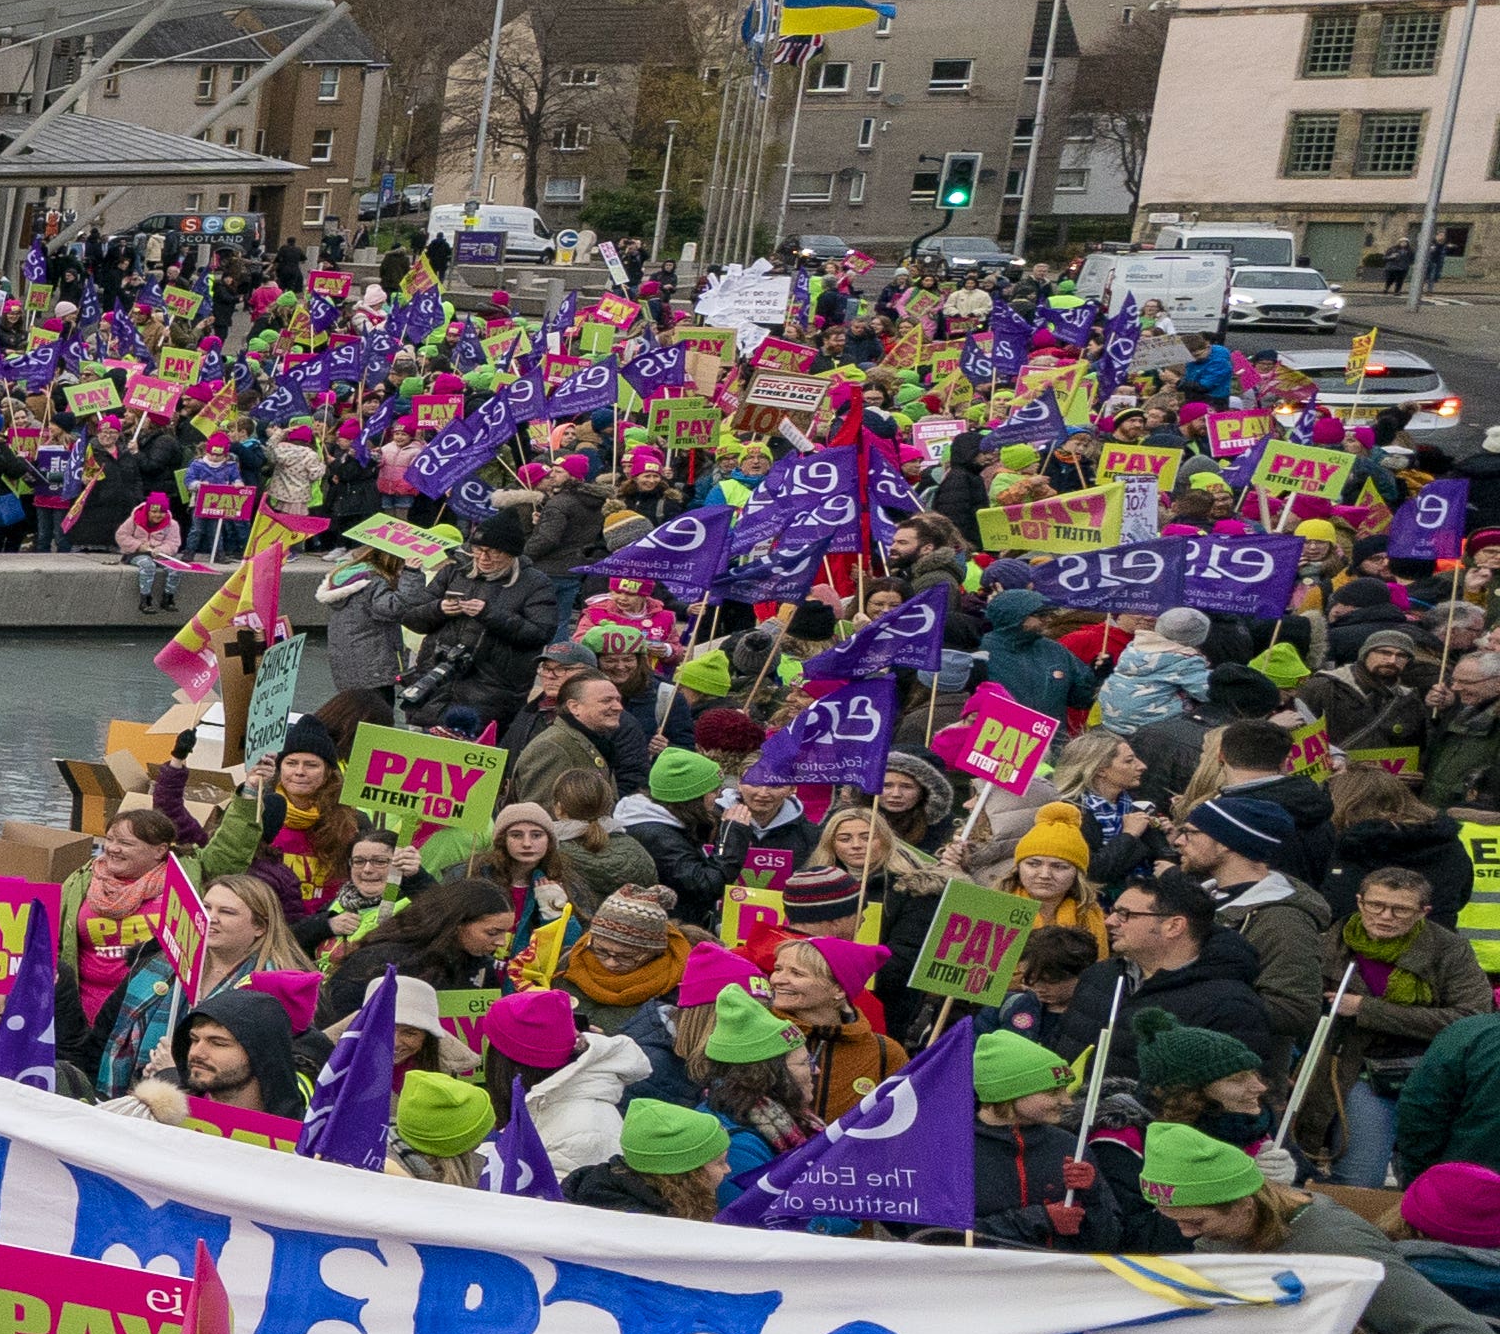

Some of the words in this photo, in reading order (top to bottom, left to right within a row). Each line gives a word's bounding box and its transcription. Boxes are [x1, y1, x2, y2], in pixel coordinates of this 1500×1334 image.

[179, 235, 244, 243] SCOTLAND
[753, 388, 787, 398] STRIKE
[789, 392, 818, 401] BACK
[756, 381, 822, 394] EDUCATORS
[1126, 495, 1148, 510] 10%
[602, 633, 644, 653] 10%
[464, 751, 497, 769] eis
[365, 749, 485, 802] PAY
[1010, 905, 1032, 927] eis
[935, 911, 1021, 972] PAY
